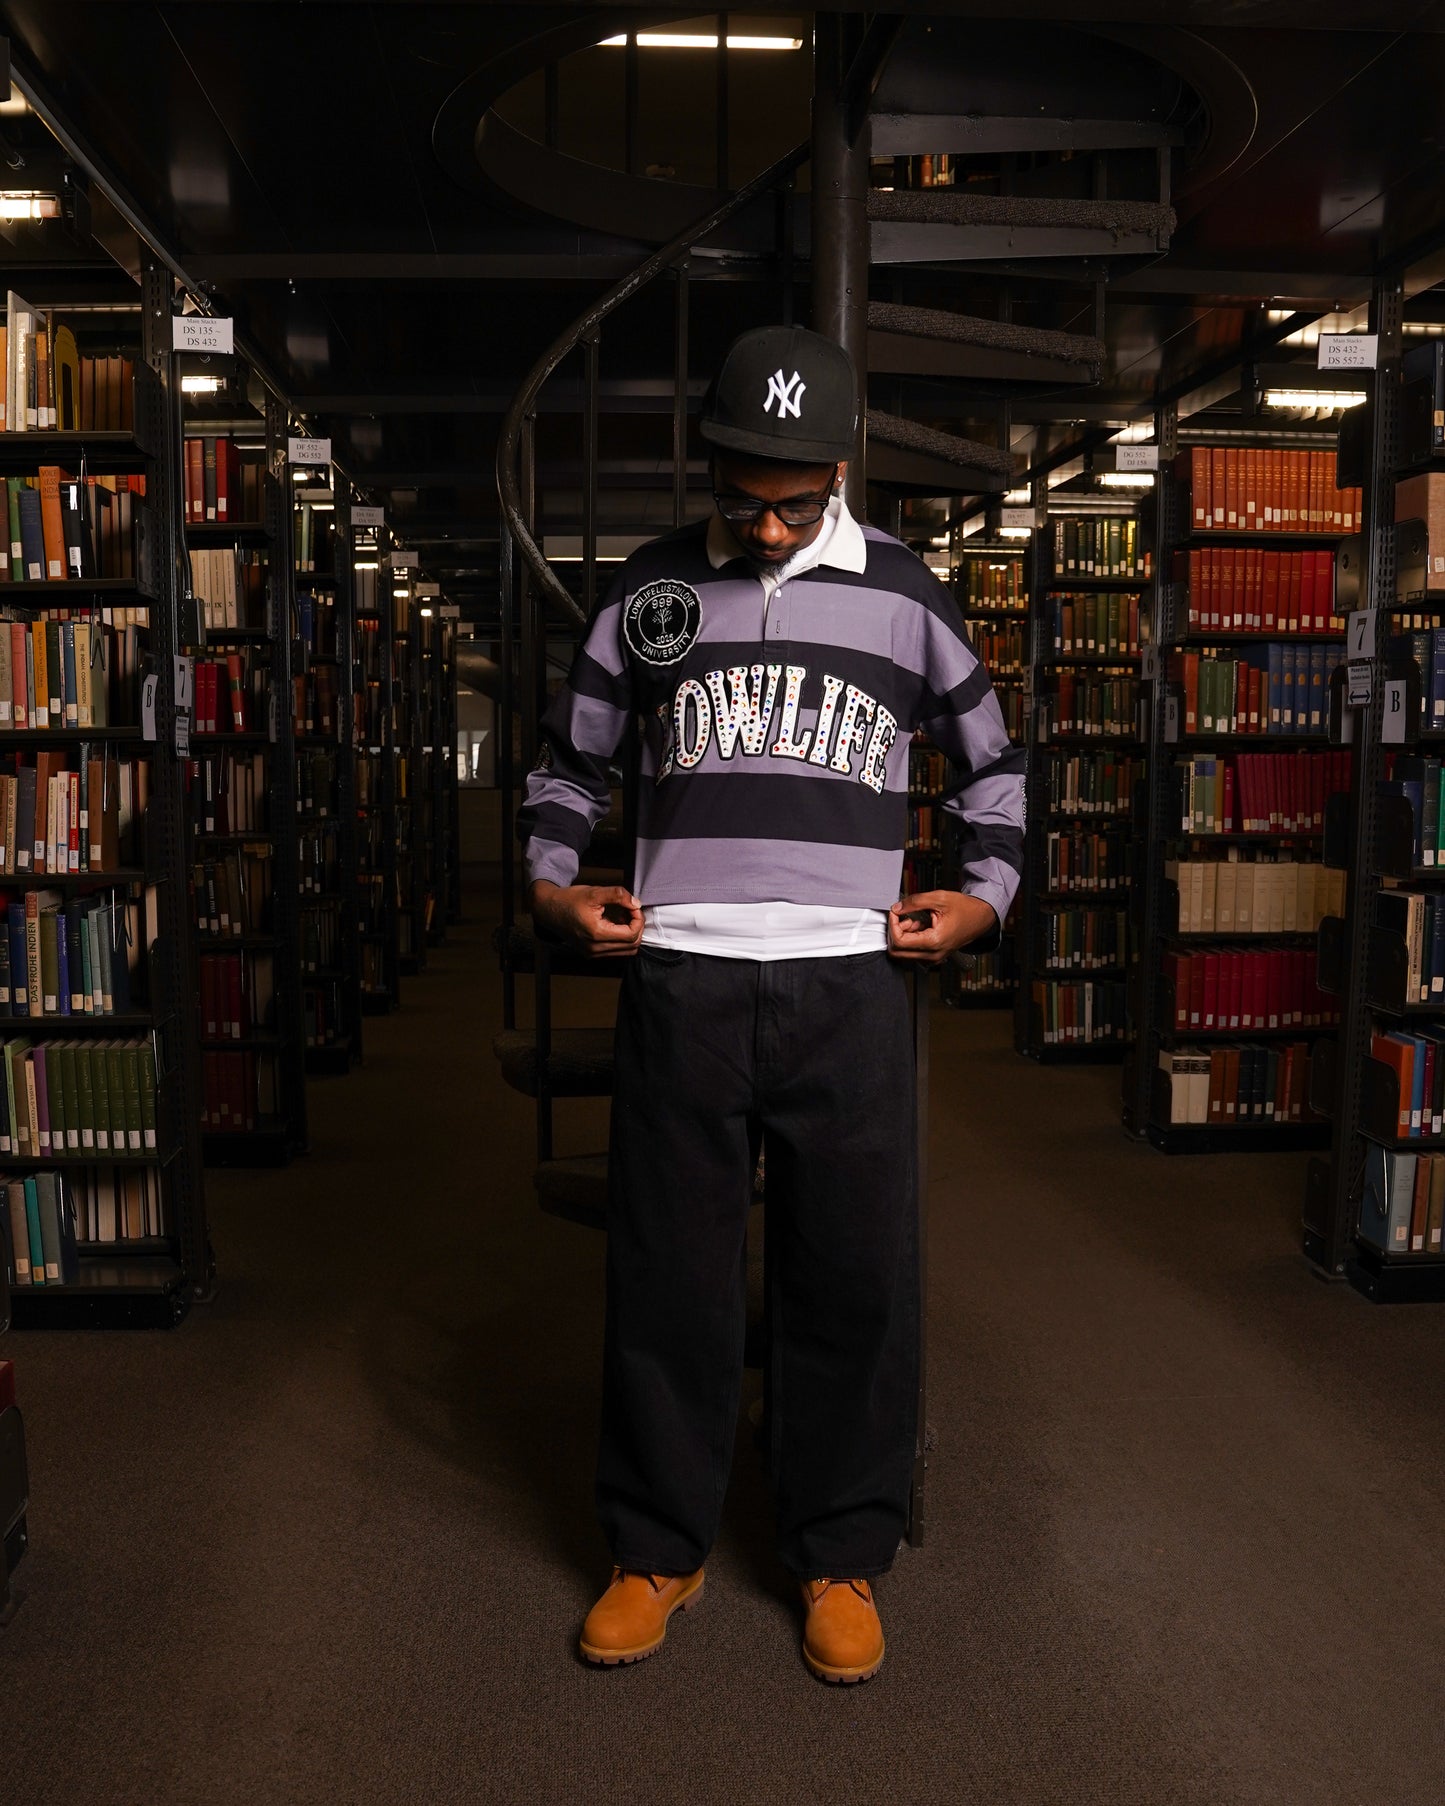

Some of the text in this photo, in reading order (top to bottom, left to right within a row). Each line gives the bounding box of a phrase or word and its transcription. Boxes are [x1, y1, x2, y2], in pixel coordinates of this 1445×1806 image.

[183, 326, 196, 334] DS
[199, 327, 213, 335] 135
[187, 338, 217, 347] DS 432
[1328, 345, 1341, 353] DS
[1343, 345, 1358, 353] 432
[1328, 357, 1365, 365] DS 557.2
[763, 368, 806, 419] NY
[651, 597, 673, 609] 999
[655, 633, 674, 644] 2025
[1355, 617, 1368, 651] 7
[641, 631, 691, 658] UNIVERSITY
[179, 664, 186, 698] 7
[146, 685, 152, 707] B
[1391, 690, 1400, 712] B
[1169, 705, 1175, 721] B
[28, 922, 37, 953] INDIEN
[30, 985, 38, 1003] DAS
